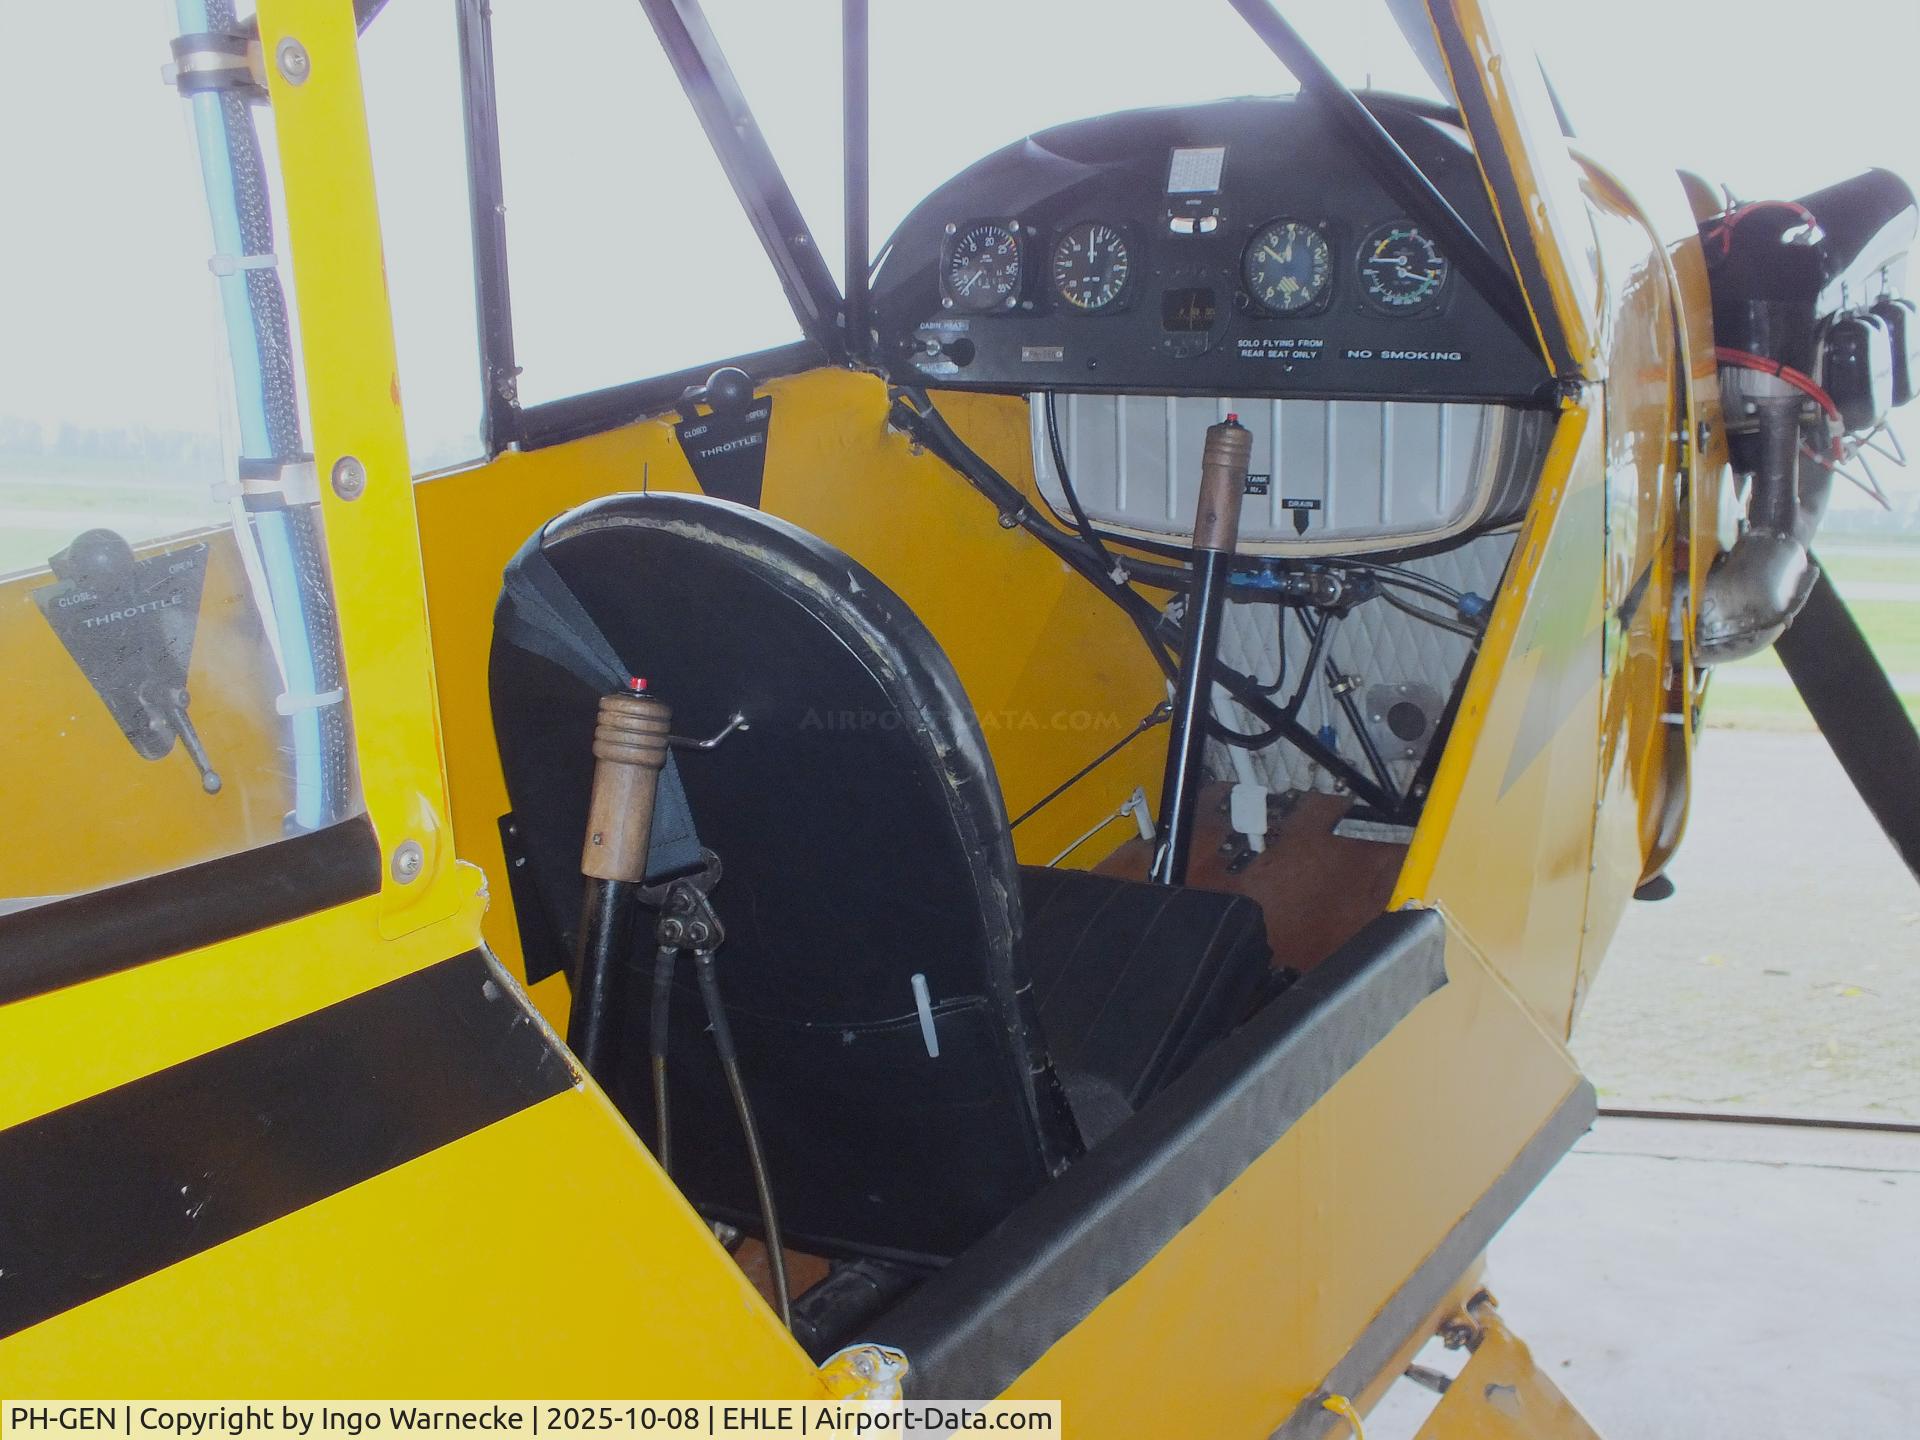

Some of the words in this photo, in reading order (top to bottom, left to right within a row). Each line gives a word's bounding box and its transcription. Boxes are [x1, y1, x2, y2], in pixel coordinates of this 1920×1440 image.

[984, 237, 995, 247] 20
[1270, 235, 1279, 247] 9
[1258, 251, 1266, 262] 8
[1314, 247, 1322, 259] 2
[1258, 272, 1265, 283] 7
[1312, 274, 1321, 286] 3
[1266, 286, 1274, 298] 6
[1301, 286, 1310, 300] 4
[1284, 293, 1291, 304] 5
[1237, 339, 1260, 348] SOLO
[1263, 339, 1294, 348] FLYING
[1297, 339, 1323, 348] FROM
[1240, 349, 1265, 358] REAR
[1268, 350, 1290, 359] SEAT
[1292, 350, 1317, 359] ONLY
[1347, 350, 1373, 360] NO
[1380, 350, 1462, 361] SMOKING
[683, 425, 708, 439] CLOSED
[700, 435, 758, 458] THROTTLE
[1288, 500, 1314, 508] DRAIN
[83, 595, 184, 629] THROTTLE
